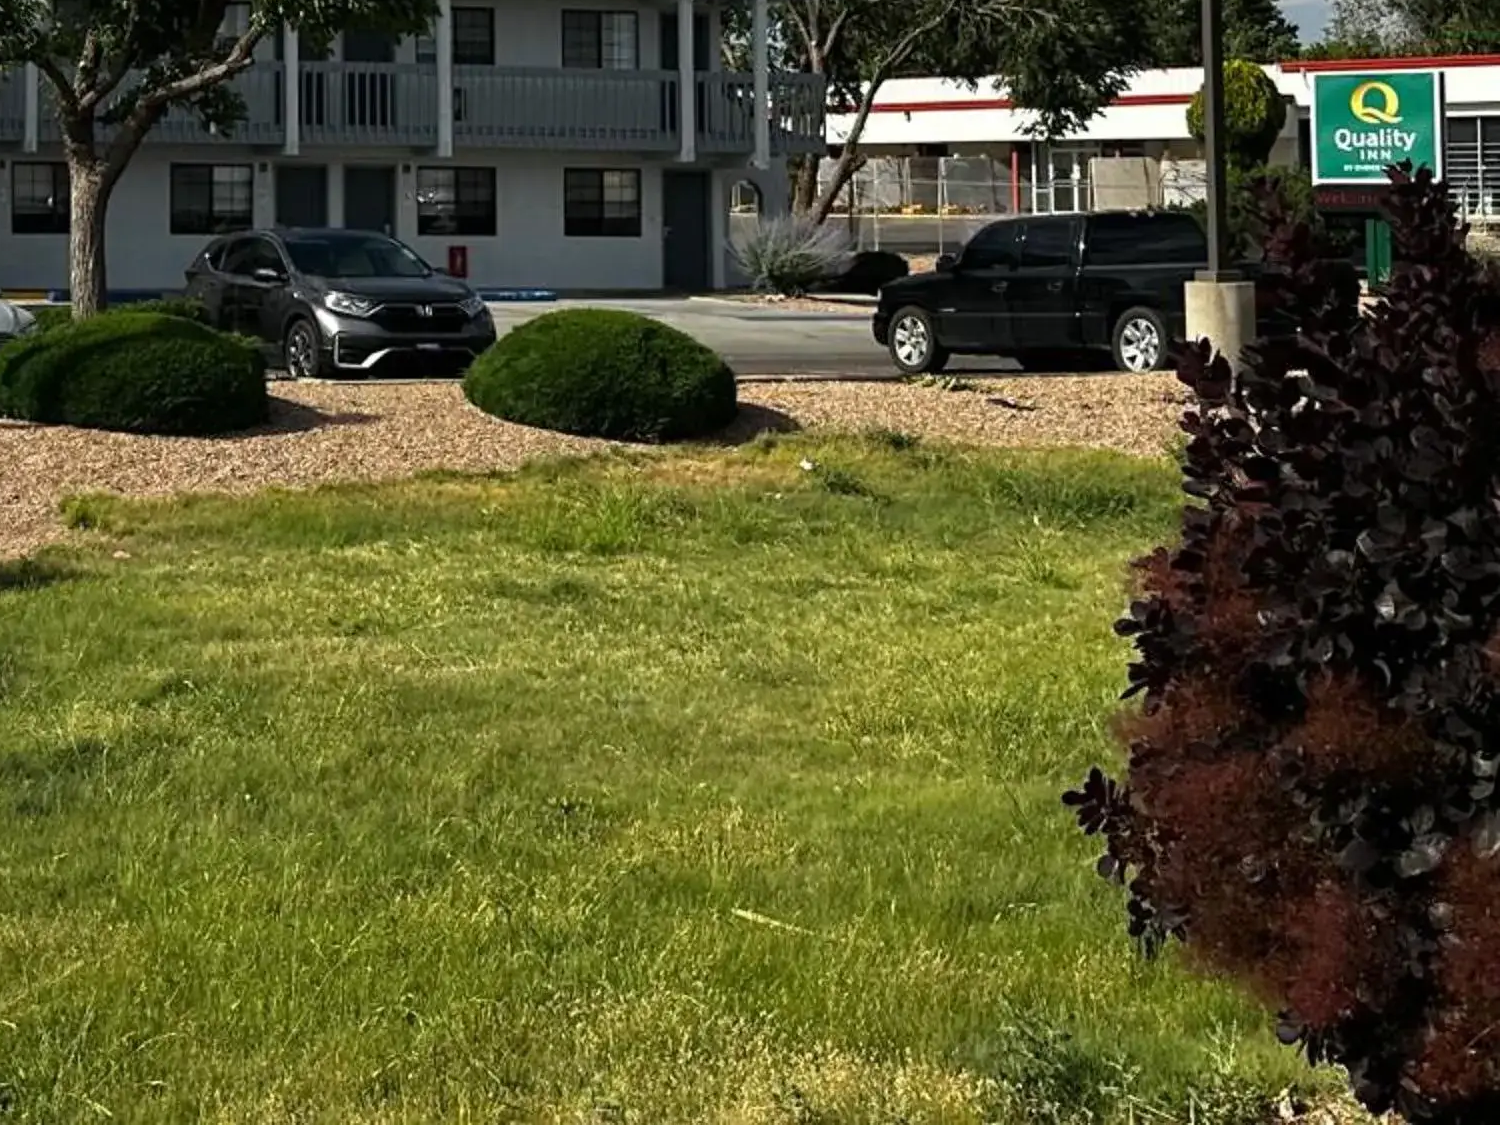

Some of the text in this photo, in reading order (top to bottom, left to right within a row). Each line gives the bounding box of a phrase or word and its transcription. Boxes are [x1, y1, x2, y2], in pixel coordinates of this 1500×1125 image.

[1351, 81, 1403, 124] Q
[1334, 128, 1417, 151] Quality
[1359, 149, 1392, 160] INN
